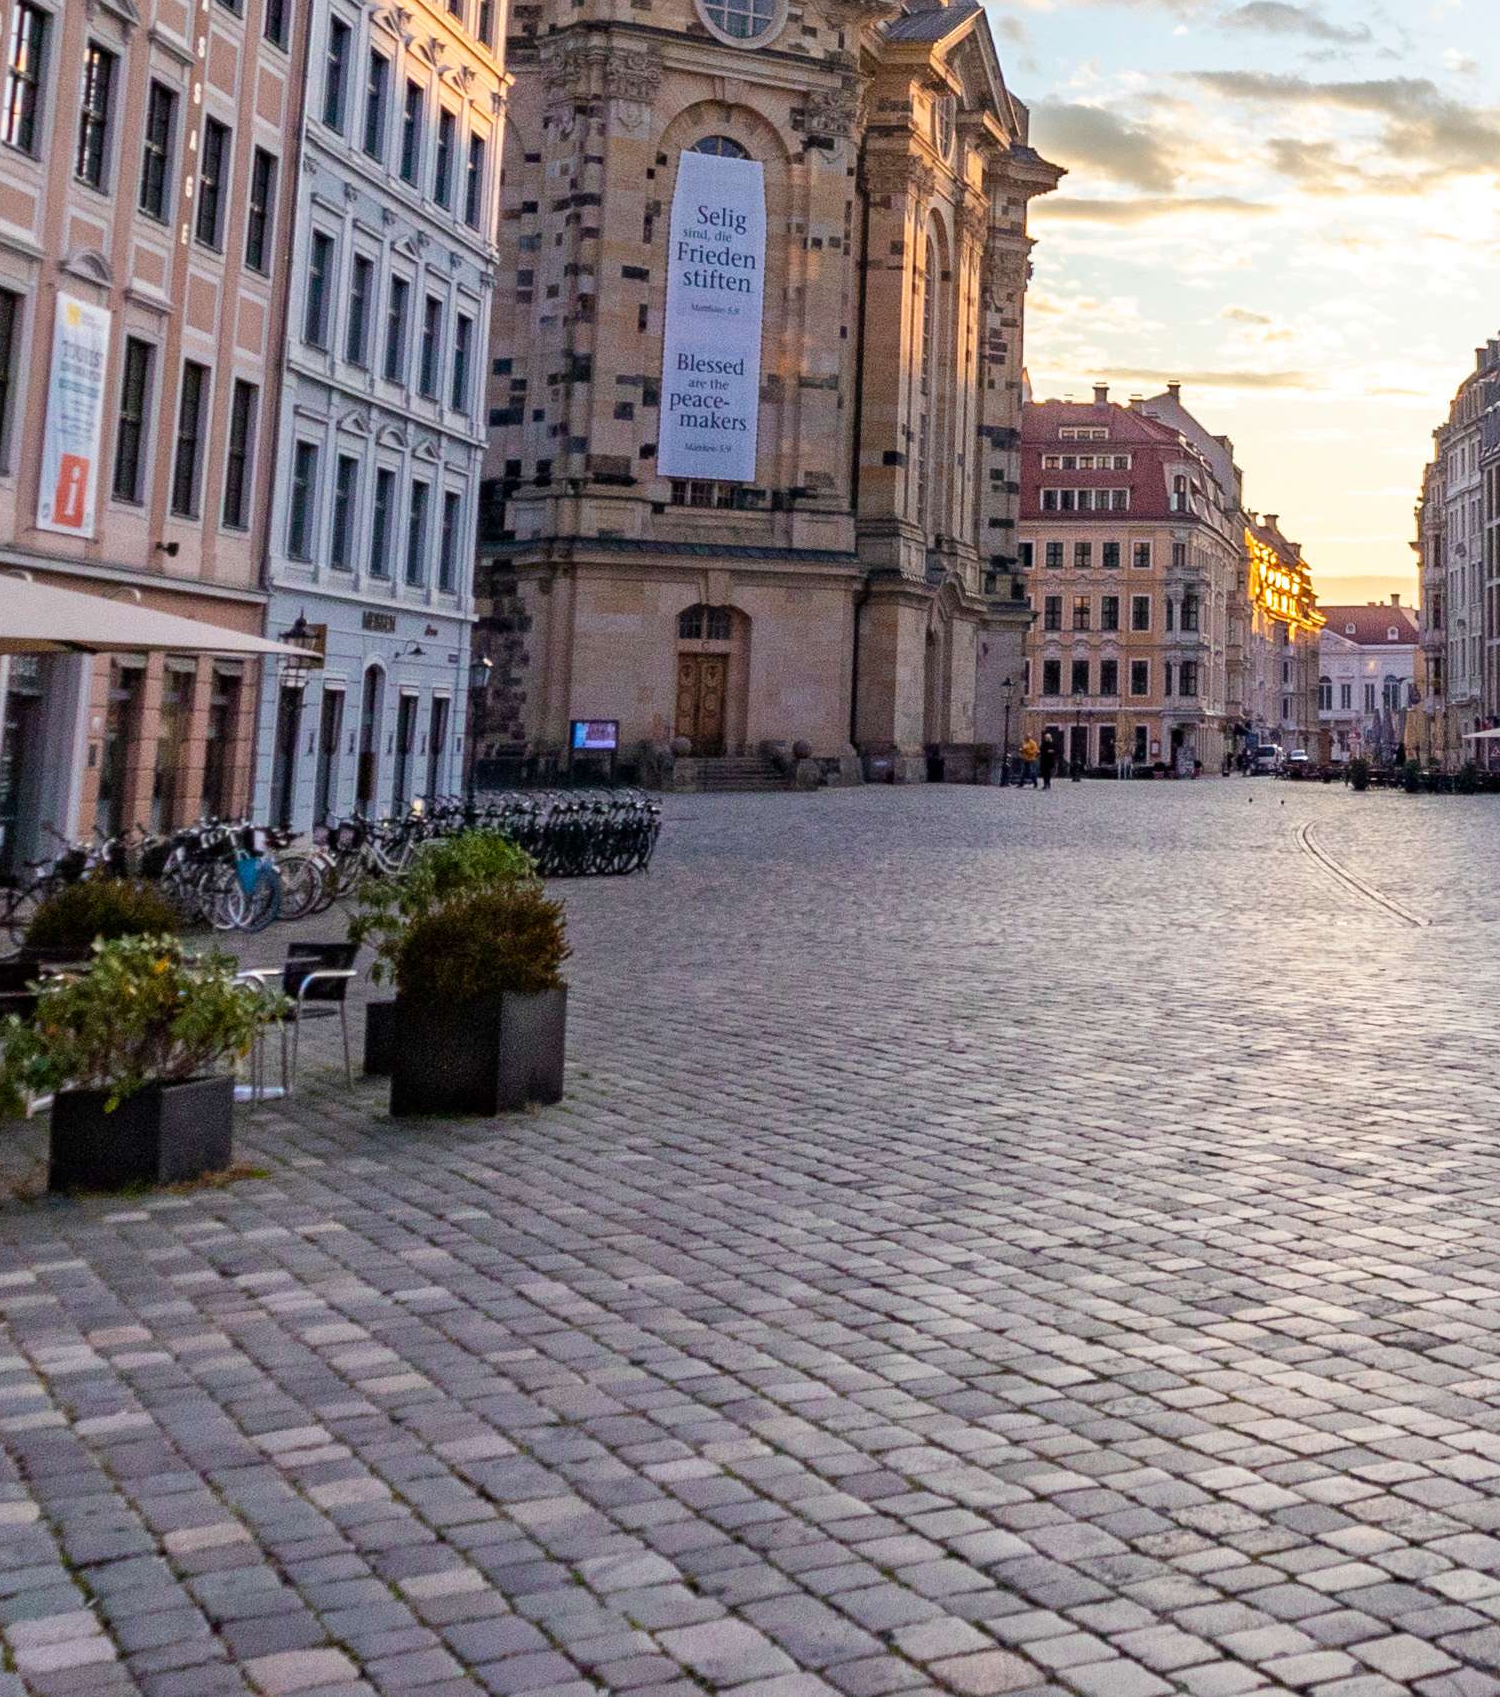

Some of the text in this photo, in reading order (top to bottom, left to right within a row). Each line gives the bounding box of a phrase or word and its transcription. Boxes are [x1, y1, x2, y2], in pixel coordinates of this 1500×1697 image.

[697, 205, 747, 235] Selig
[683, 228, 732, 242] sind, die
[677, 242, 756, 270] Frieden
[677, 353, 745, 376] Blessed
[688, 379, 730, 390] are the
[669, 393, 731, 411] peace-
